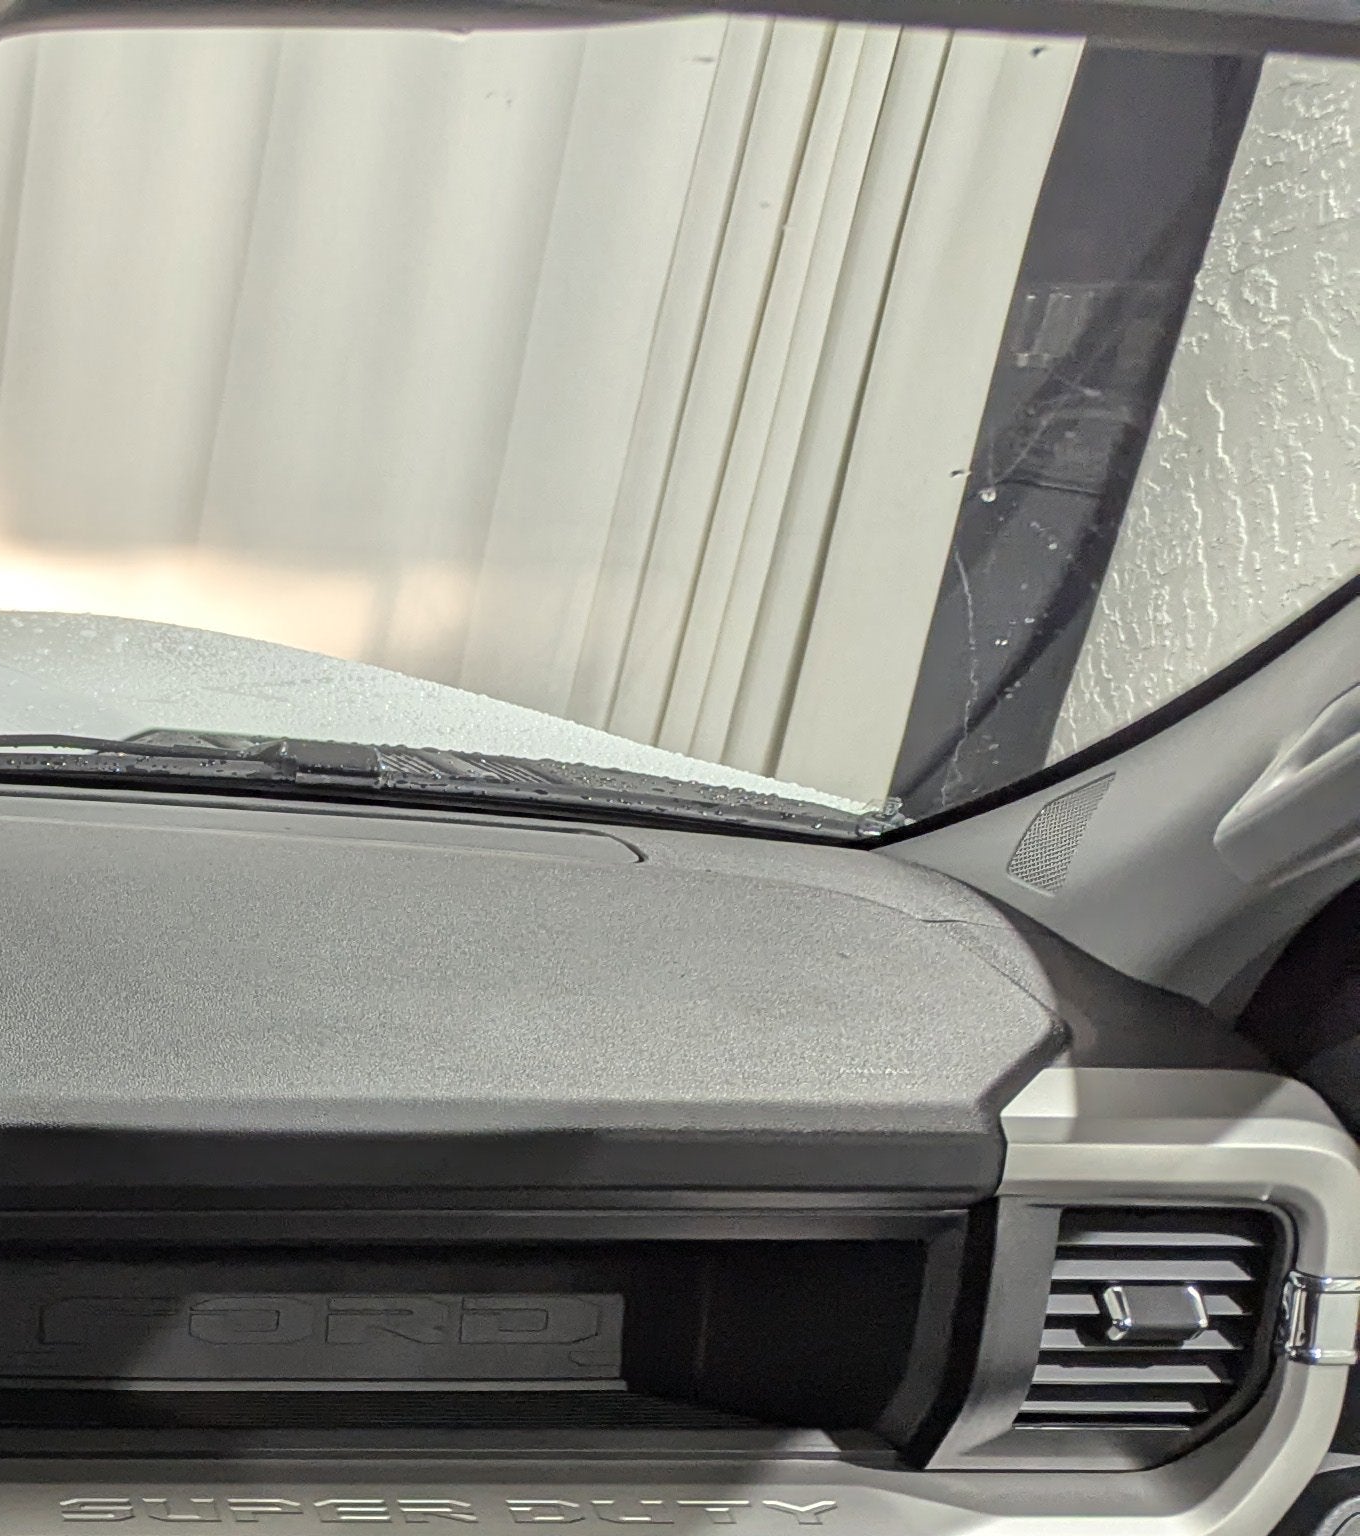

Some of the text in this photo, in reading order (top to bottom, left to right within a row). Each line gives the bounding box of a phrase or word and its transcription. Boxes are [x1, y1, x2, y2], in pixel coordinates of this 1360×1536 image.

[39, 1294, 600, 1345] FORD
[58, 1497, 838, 1525] SUPER DUTY
